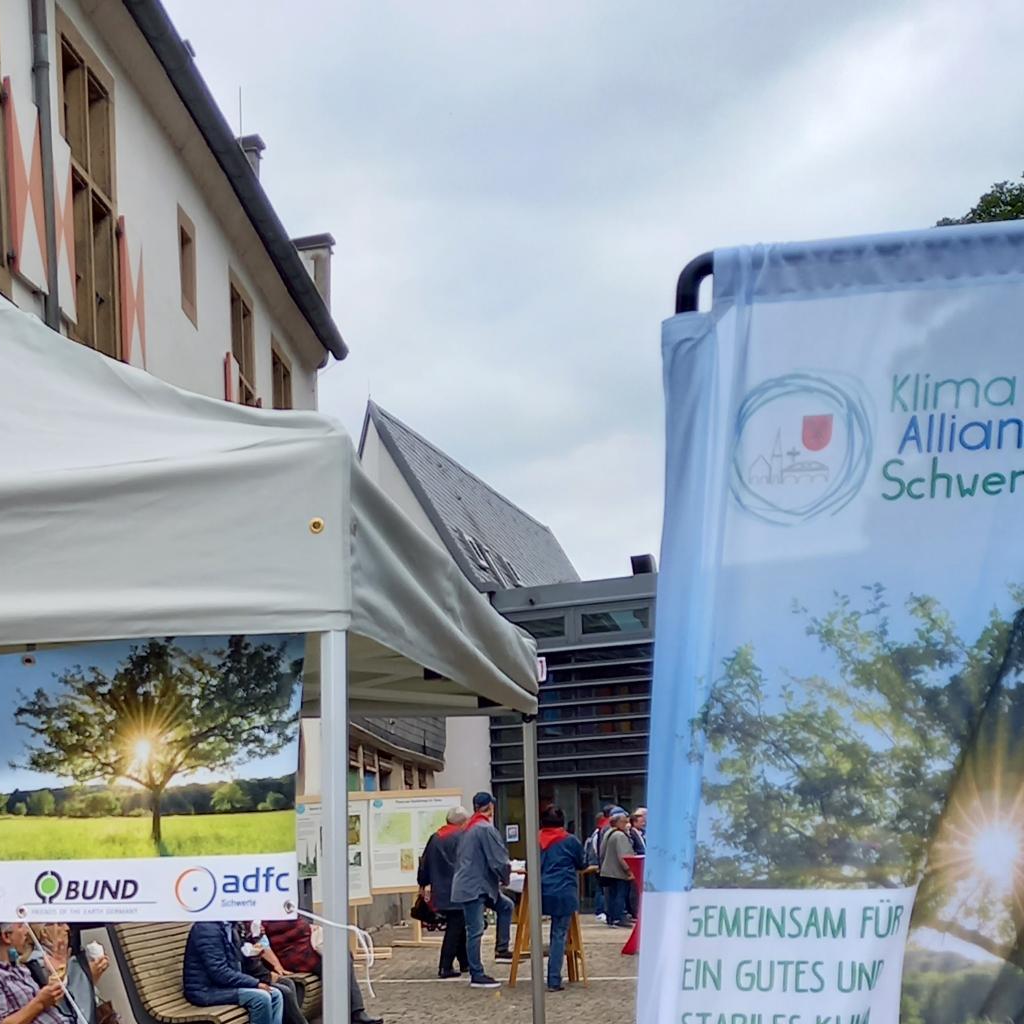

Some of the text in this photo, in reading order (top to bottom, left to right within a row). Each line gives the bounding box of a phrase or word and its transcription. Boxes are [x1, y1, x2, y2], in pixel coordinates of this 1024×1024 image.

[891, 373, 1017, 413] Klima
[898, 412, 1024, 454] Allian
[881, 456, 1024, 501] Schwer
[65, 879, 139, 901] BUND
[222, 867, 290, 894] adfc
[220, 897, 257, 908] Schwerte
[687, 898, 905, 939] GEMEINSAM FÜR
[681, 958, 723, 992] EIN
[735, 960, 825, 993] GUTES
